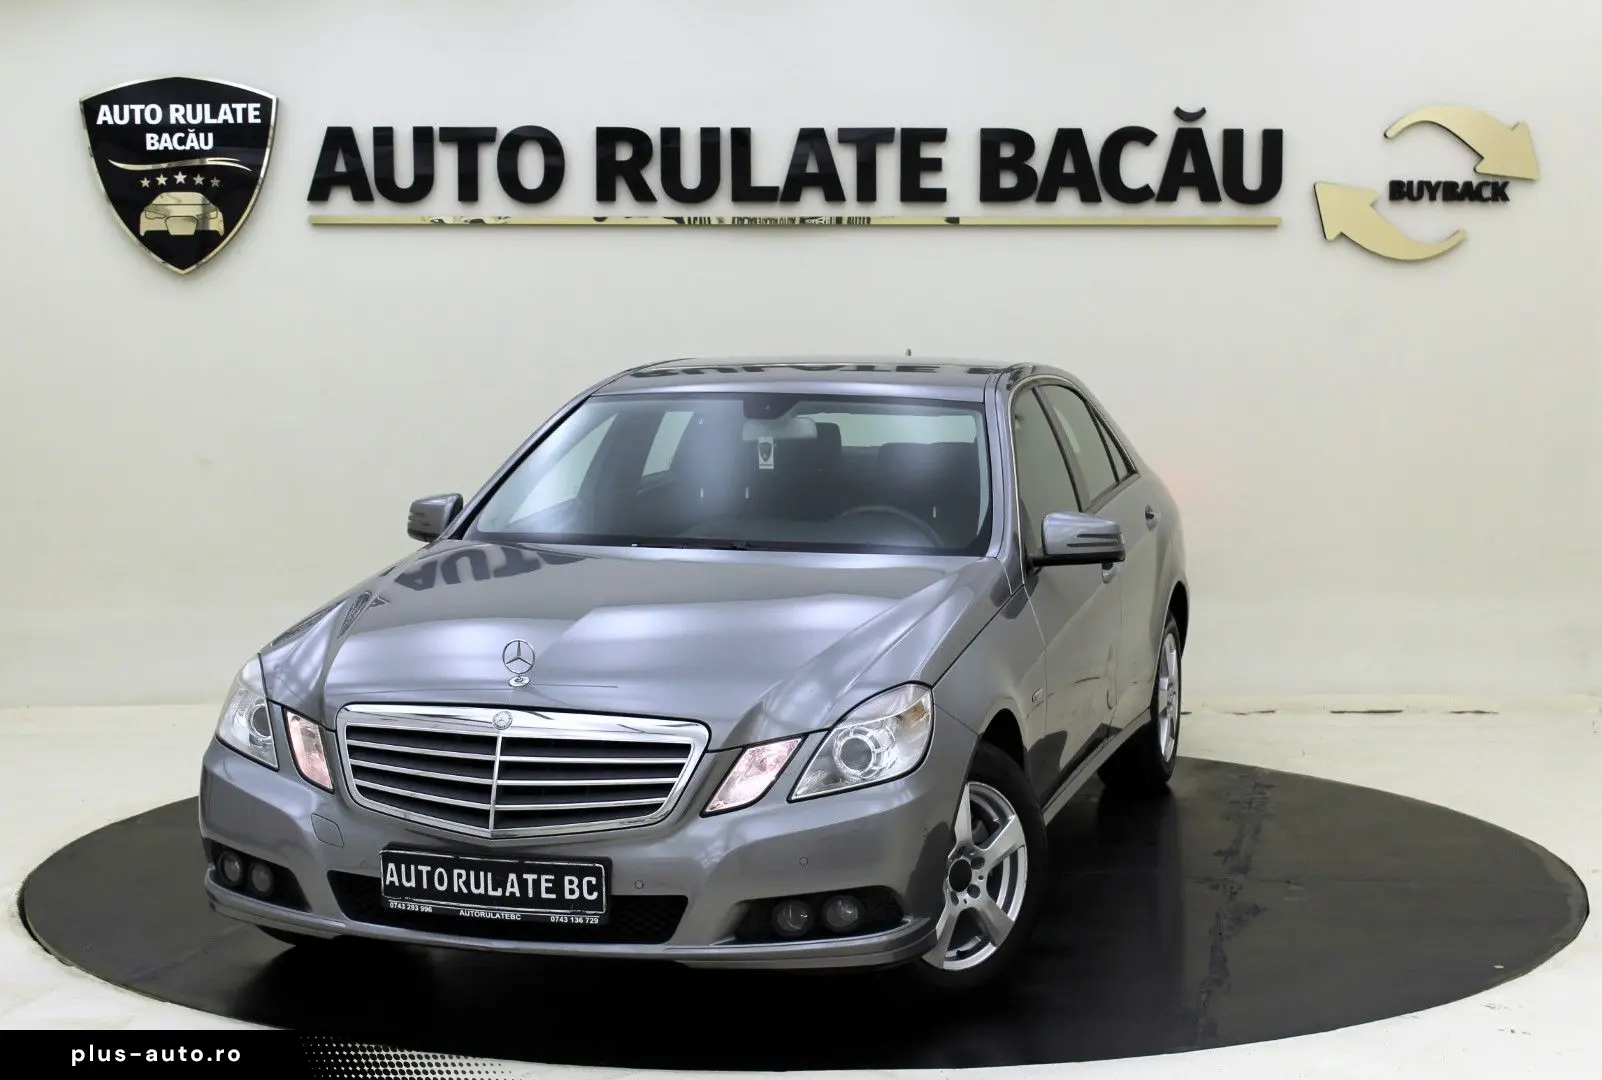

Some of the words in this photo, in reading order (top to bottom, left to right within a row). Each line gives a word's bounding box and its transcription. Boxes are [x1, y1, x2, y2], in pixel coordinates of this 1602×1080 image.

[96, 104, 163, 125] AUTO
[170, 103, 262, 124] RULATE
[145, 129, 214, 151] BACĂU
[307, 126, 566, 205] AUTO
[595, 127, 948, 205] RULATE
[979, 106, 1285, 206] BACĂU
[1388, 180, 1510, 202] BUYBACK
[564, 875, 599, 901] BC
[389, 901, 406, 911] 0743
[459, 909, 522, 922] AUTORULATEBC
[550, 915, 568, 923] 0743
